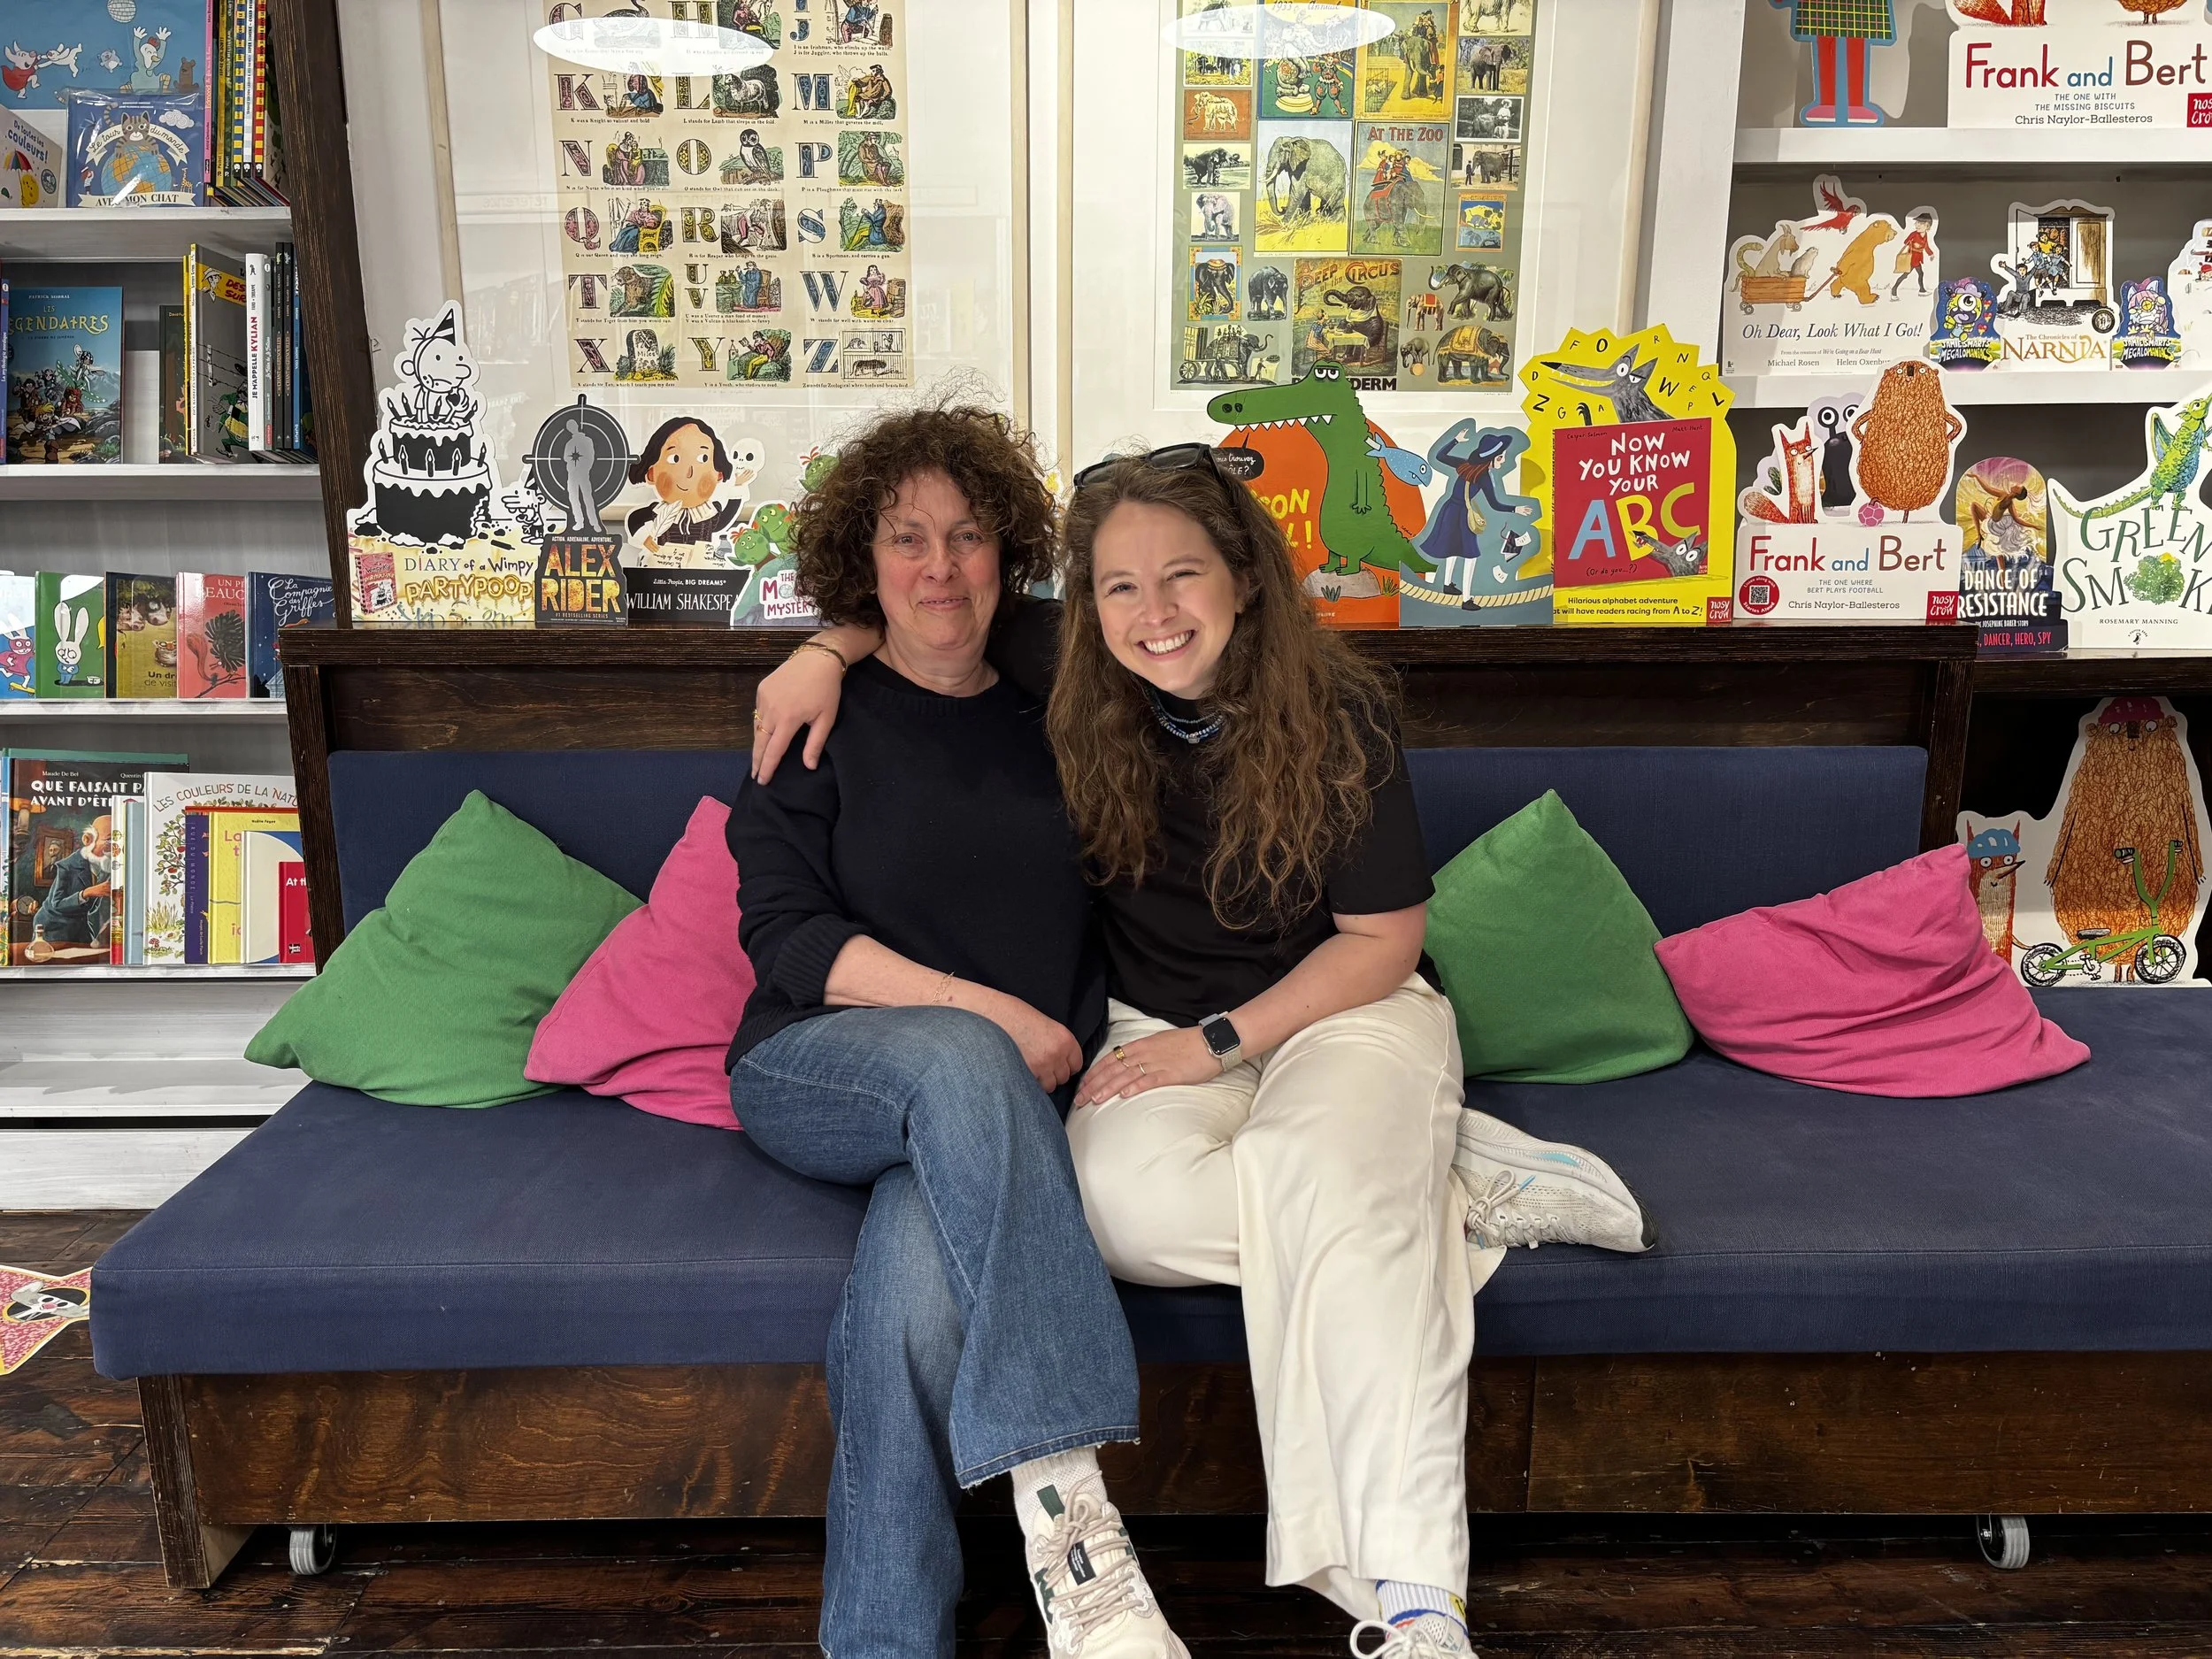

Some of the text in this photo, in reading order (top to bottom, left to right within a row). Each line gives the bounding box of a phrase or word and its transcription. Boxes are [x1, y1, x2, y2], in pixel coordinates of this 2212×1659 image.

[1966, 40, 2208, 88] Frank and Bert
[554, 73, 604, 111] K
[791, 73, 834, 111] M
[2053, 103, 2092, 111] MISSING
[2094, 102, 2135, 111] BISCUITS
[2015, 114, 2153, 127] Chris Naylor-Ballesteros
[89, 126, 185, 154] Le tour du monde
[1368, 127, 1444, 142] AT THE ZOO
[8, 130, 49, 165] couleurs!
[559, 140, 593, 177] N
[151, 194, 180, 204] CHAT
[680, 206, 721, 242] R
[1345, 261, 1400, 285] CIRCUS
[568, 273, 608, 309] T
[799, 271, 849, 312] W
[1742, 322, 1924, 340] Oh Dear, Look What I Got!
[803, 338, 839, 373] Z
[2002, 336, 2107, 363] NARNIA
[1767, 358, 1796, 367] Michael
[252, 390, 257, 399] JE
[1611, 433, 1665, 457] NOW
[1228, 453, 1256, 465] trouvez
[1578, 449, 1691, 481] YOU KNOW
[1609, 474, 1659, 496] YOUR
[1568, 482, 1701, 562] ABC
[2080, 505, 2212, 563] GREEN
[544, 544, 616, 578] ALEX
[1749, 534, 1947, 572] Frank and Bert
[404, 557, 462, 572] DIARY
[465, 558, 475, 572] of
[488, 557, 534, 576] Wimpy
[780, 572, 795, 582] THE
[1586, 566, 1599, 577] (Or
[267, 577, 333, 601] Compagnie
[284, 578, 298, 590] La
[405, 574, 534, 608] PARTYPOOP
[1964, 568, 2039, 591] DANCE OF
[541, 578, 621, 613] RIDER
[626, 593, 671, 611] WILLIAM
[1602, 597, 1638, 606] alphabet
[1709, 599, 1731, 613] nosy
[1814, 600, 1901, 611] Naylor-Ballesteros
[1932, 595, 1955, 608] nosy
[1957, 592, 2049, 619] RESISTANCE
[274, 598, 334, 626] Griffes
[1626, 608, 1651, 617] racing
[1691, 606, 1703, 617] Z!
[1709, 609, 1730, 620] crow
[1930, 603, 1954, 617] crow
[1984, 632, 2051, 647] DANCER, HERO, SPY
[31, 780, 128, 794] QUE FAISAIT
[153, 796, 174, 812] LES
[177, 783, 234, 802] COULEURS
[237, 783, 251, 795] DE
[255, 785, 268, 797] LA
[30, 795, 73, 807] AVANT
